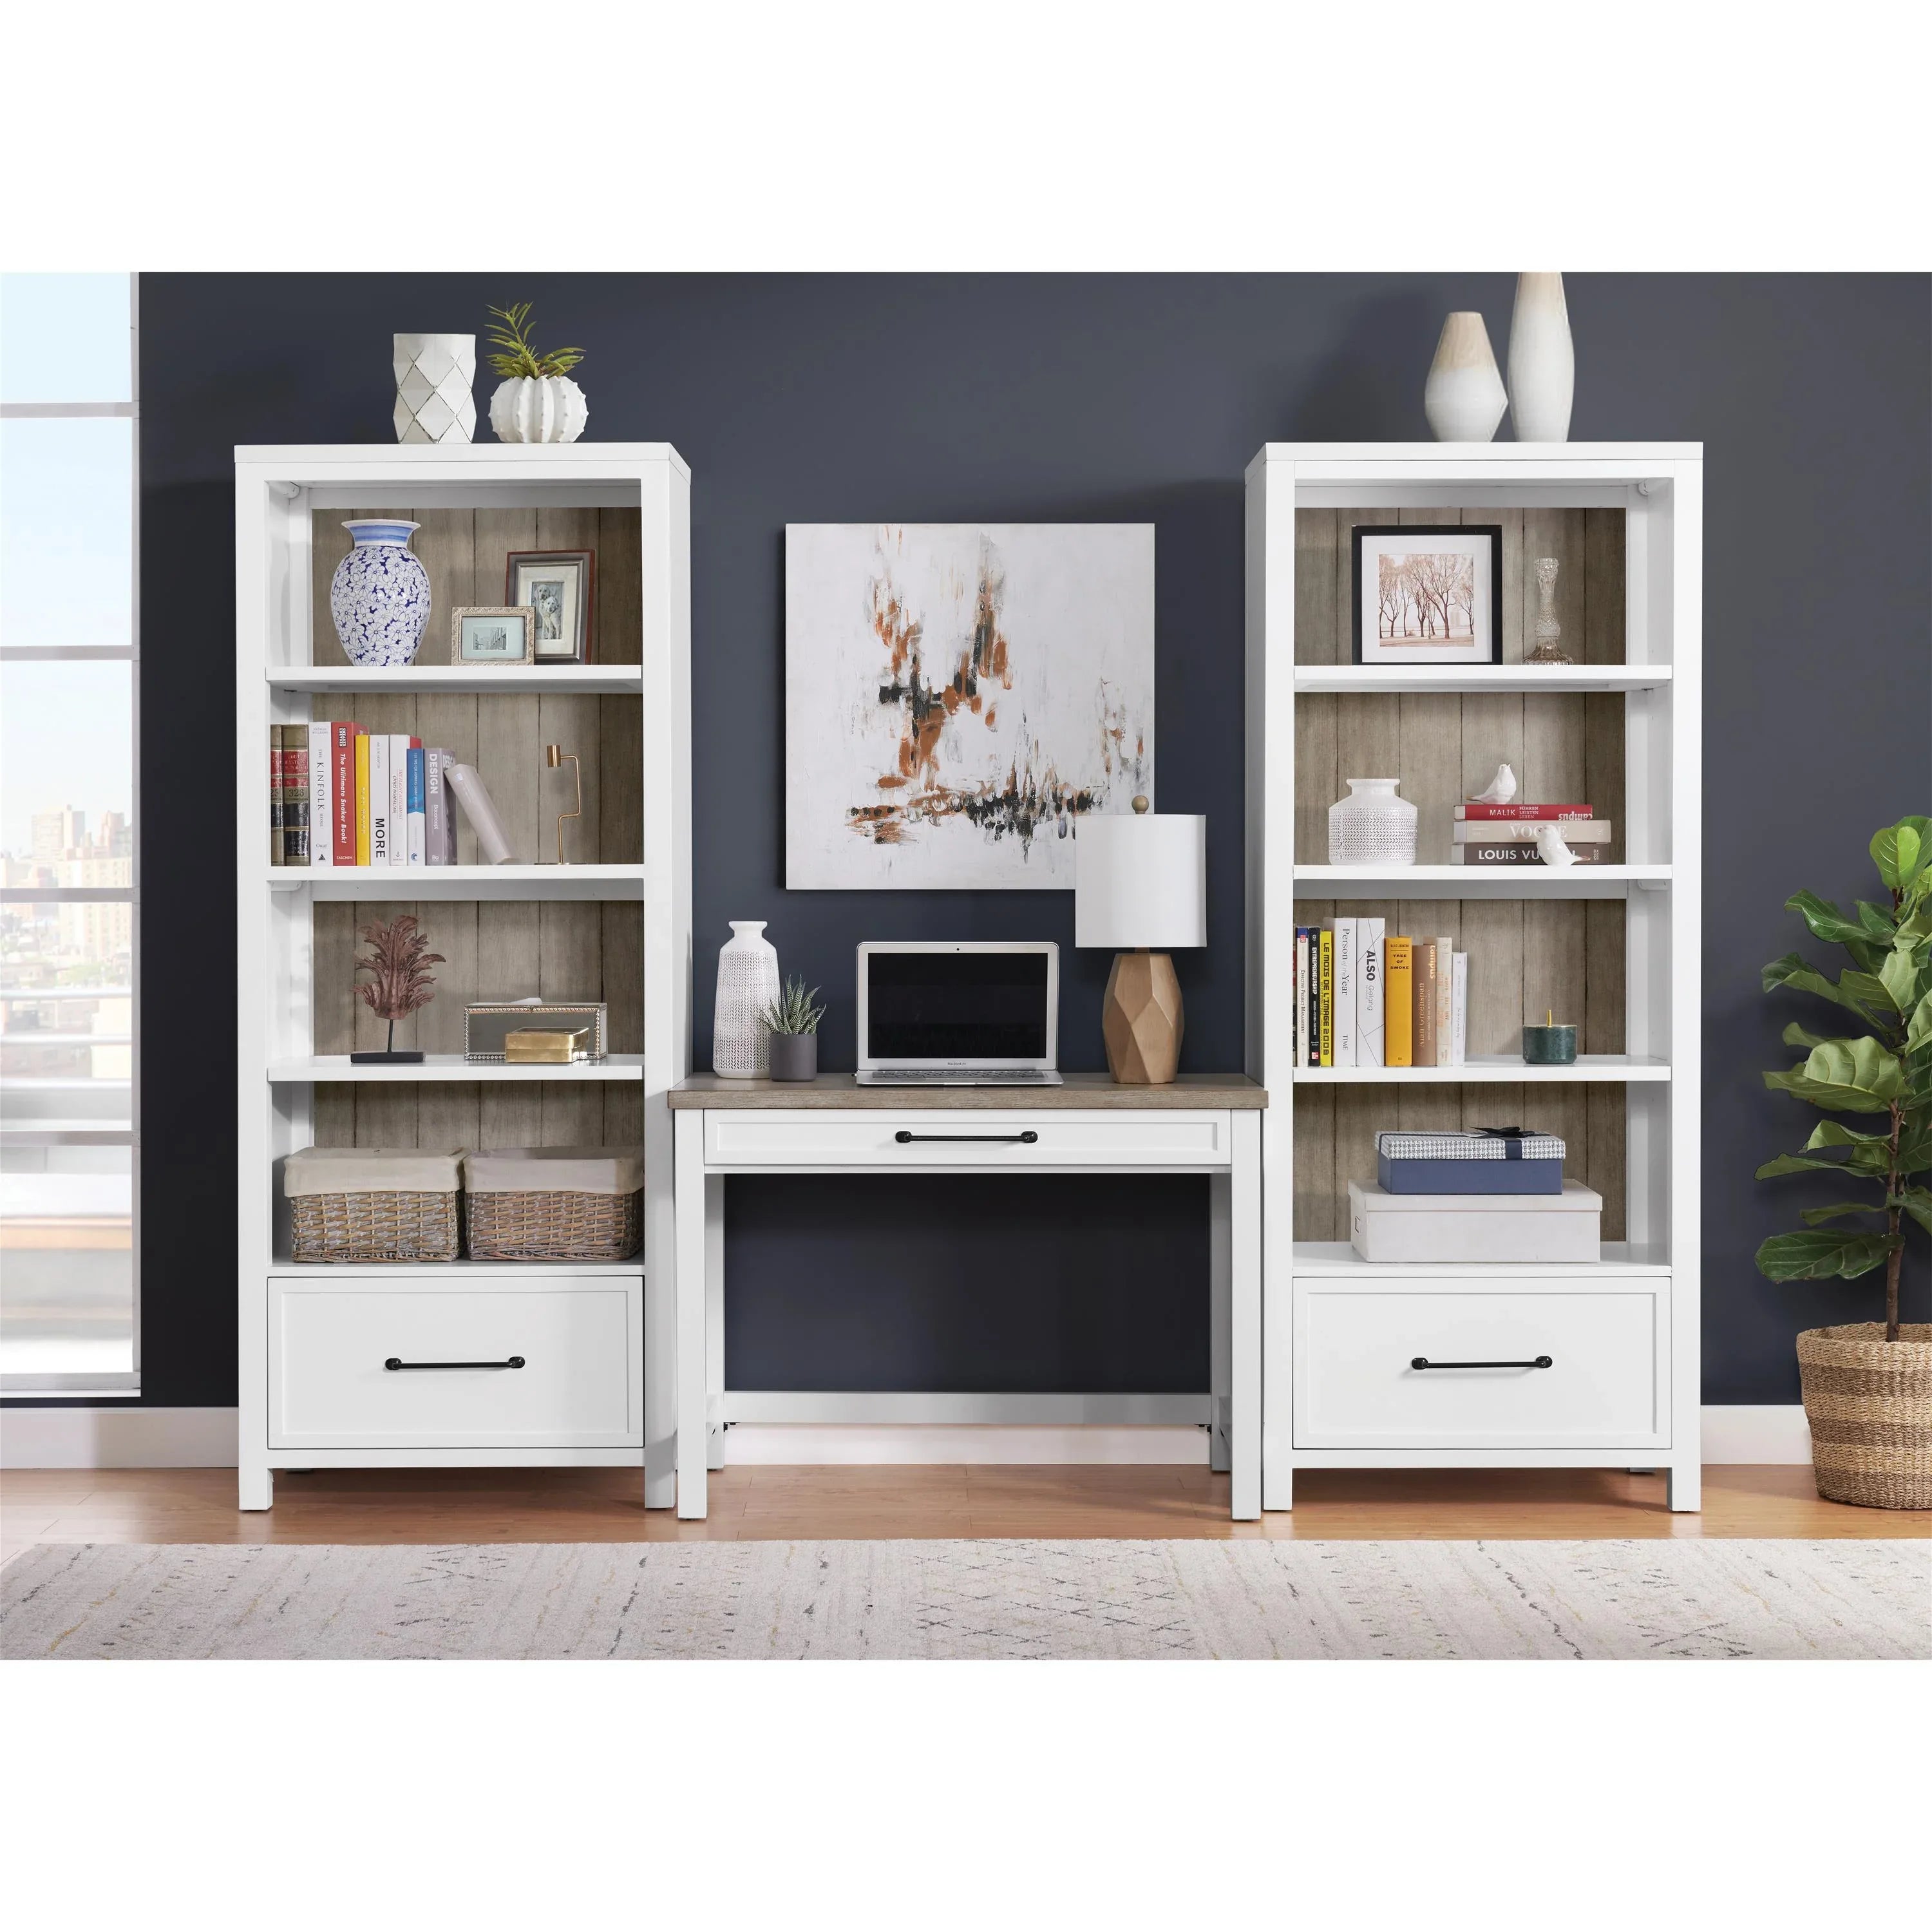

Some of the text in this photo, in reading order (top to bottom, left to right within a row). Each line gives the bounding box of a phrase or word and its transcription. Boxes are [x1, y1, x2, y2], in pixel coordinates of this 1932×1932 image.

[429, 753, 439, 794] DESIGN
[316, 762, 325, 810] KINFOLK
[289, 789, 305, 797] 326
[1558, 811, 1593, 820] campus
[375, 818, 385, 858] MORE
[1510, 825, 1567, 838] VOGE
[1479, 850, 1517, 860] LOUIS
[1323, 942, 1330, 952] LE
[1366, 951, 1376, 981] ALSO
[1323, 980, 1330, 991] DE
[1341, 975, 1350, 996] Year
